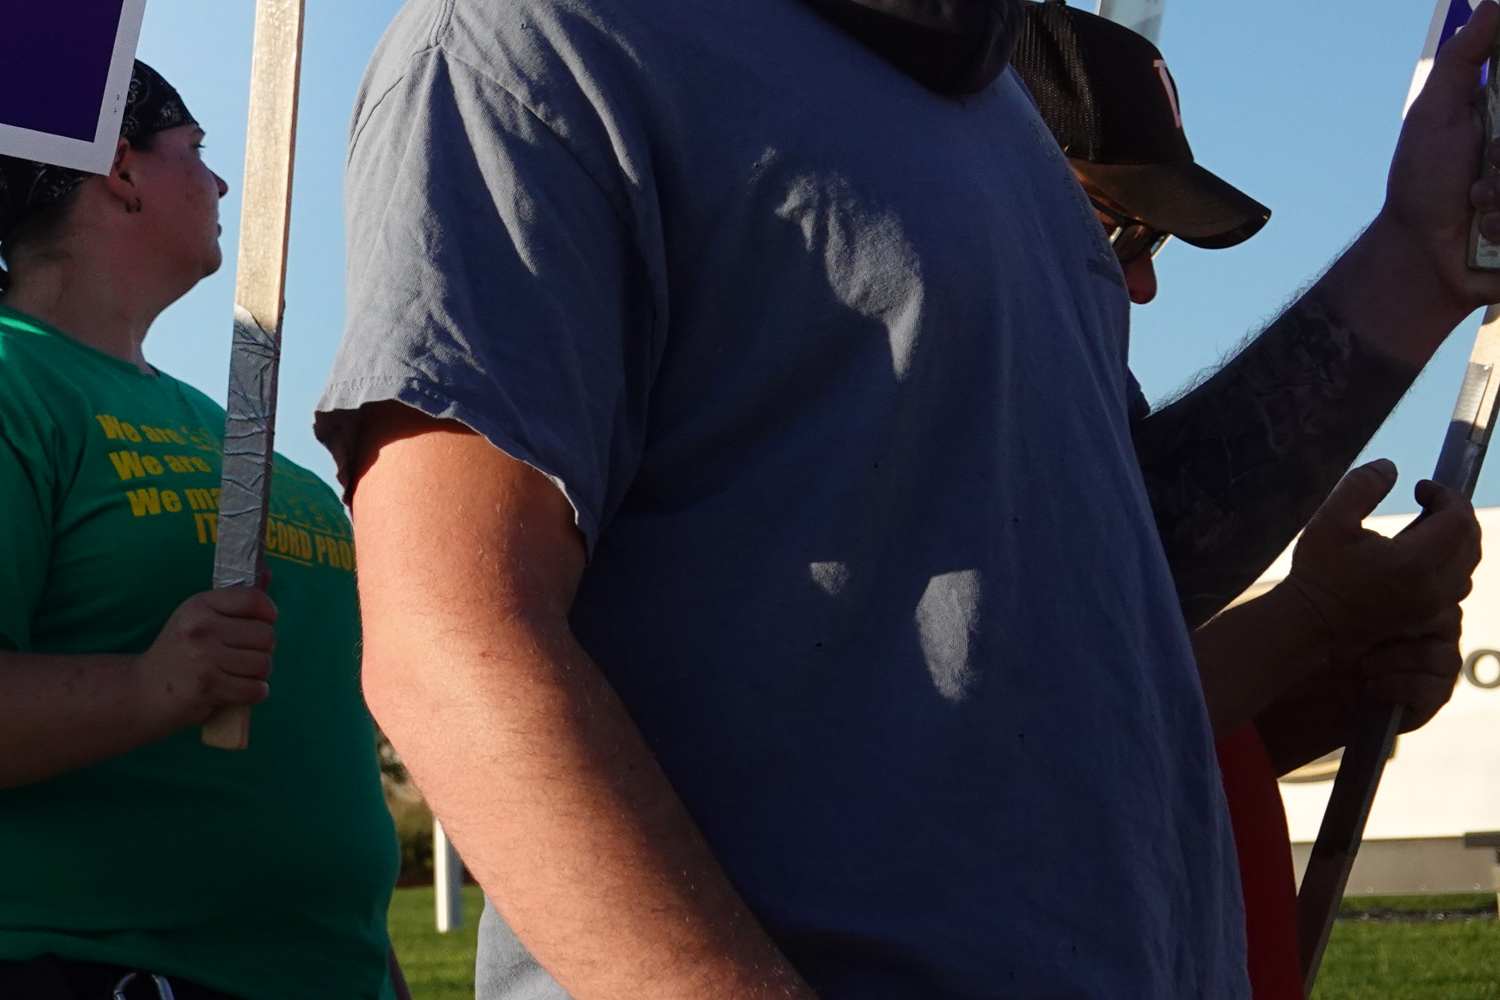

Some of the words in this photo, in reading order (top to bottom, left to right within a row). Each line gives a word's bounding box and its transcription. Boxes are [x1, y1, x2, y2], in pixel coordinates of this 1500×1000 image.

[95, 413, 142, 442] We
[141, 424, 186, 445] are
[109, 450, 164, 480] We
[163, 454, 212, 473] are
[126, 487, 183, 517] We
[265, 517, 313, 561] CORD
